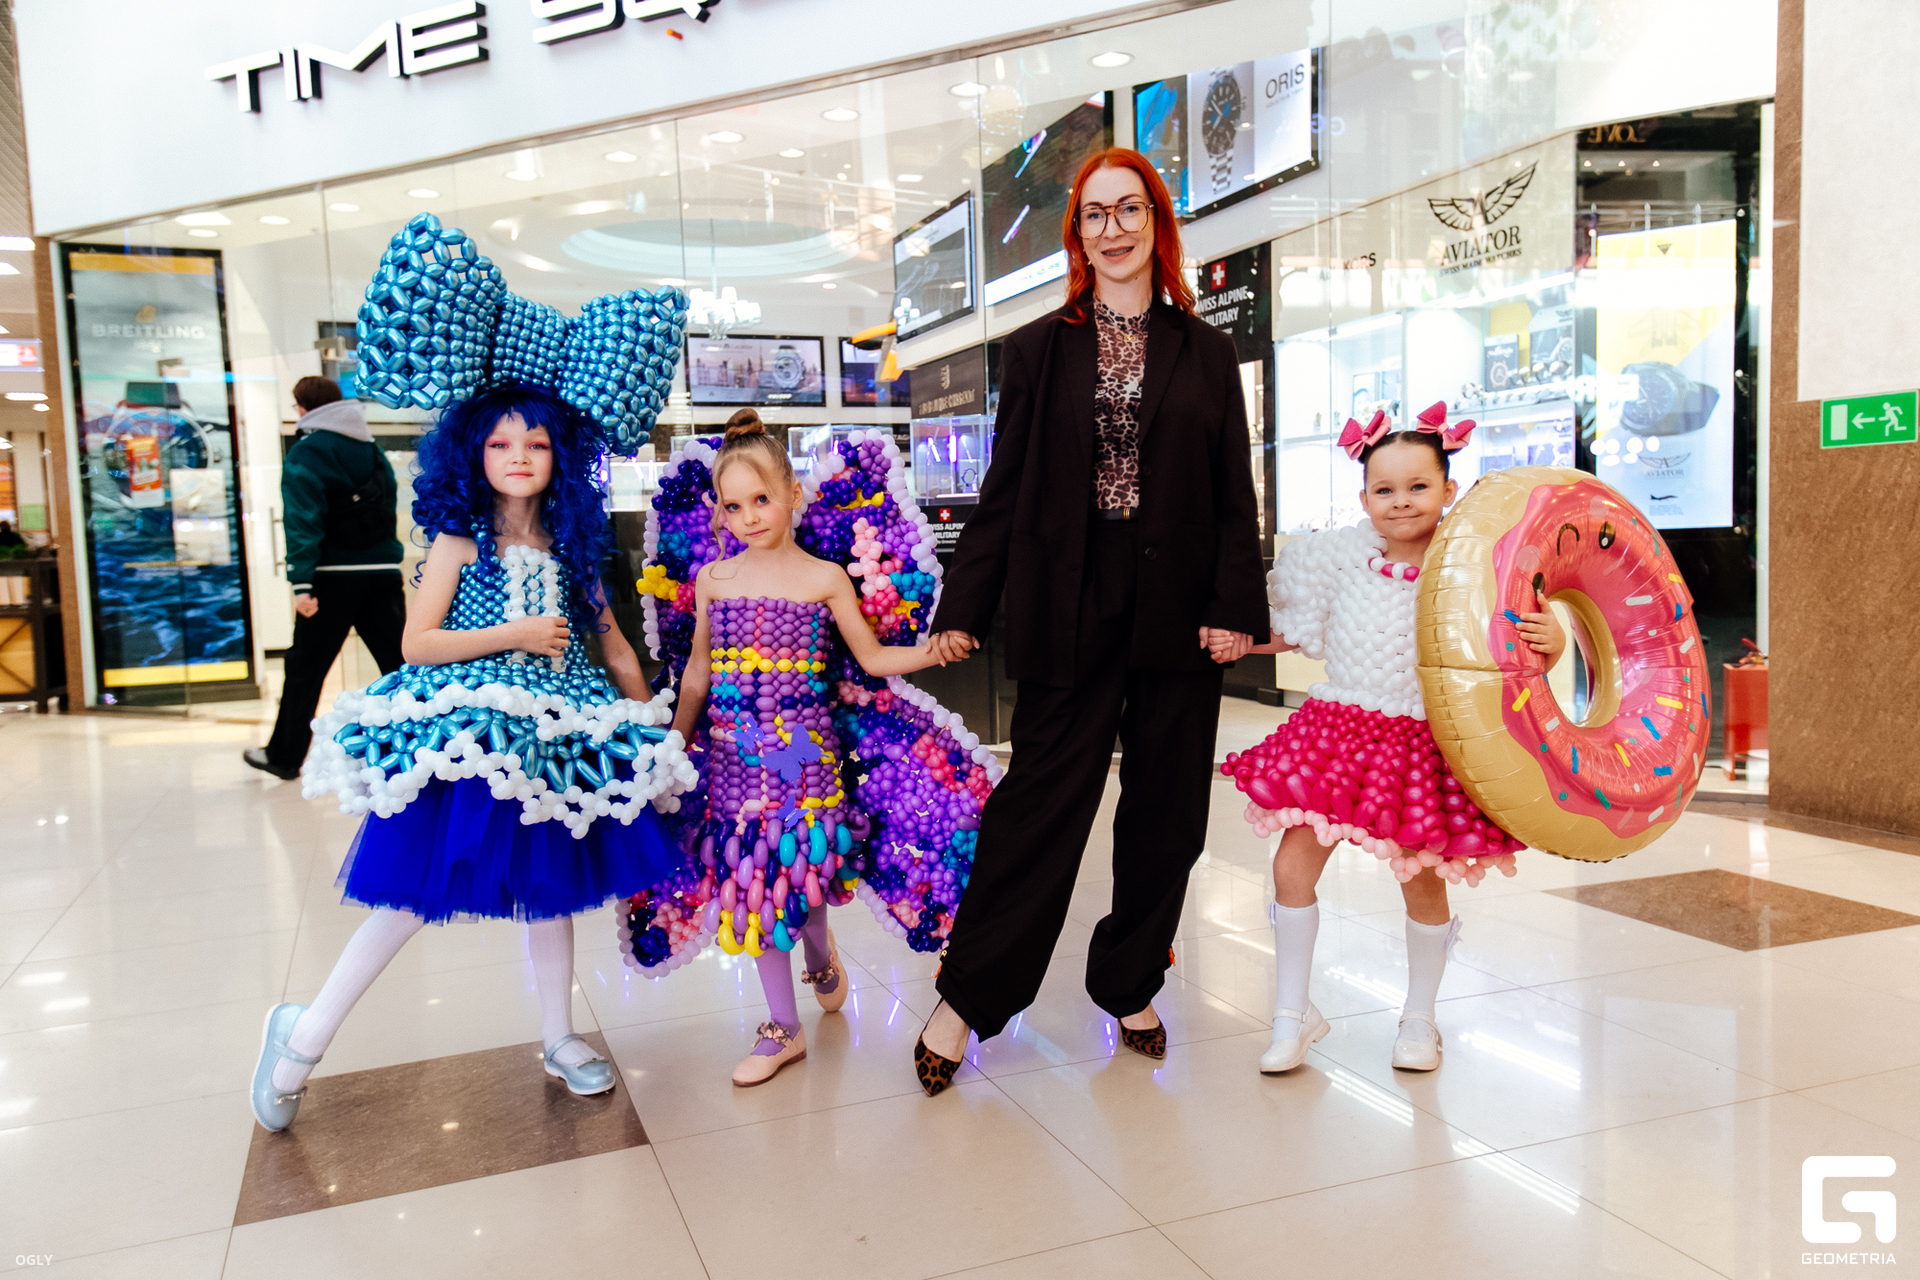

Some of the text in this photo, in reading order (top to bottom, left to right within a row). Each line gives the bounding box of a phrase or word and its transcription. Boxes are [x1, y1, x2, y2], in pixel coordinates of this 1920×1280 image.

[205, 0, 487, 113] TIME
[1265, 63, 1305, 99] ORIS
[1440, 225, 1521, 266] AVIATOR
[1218, 286, 1248, 307] ALPINE
[90, 323, 205, 339] BREITLING
